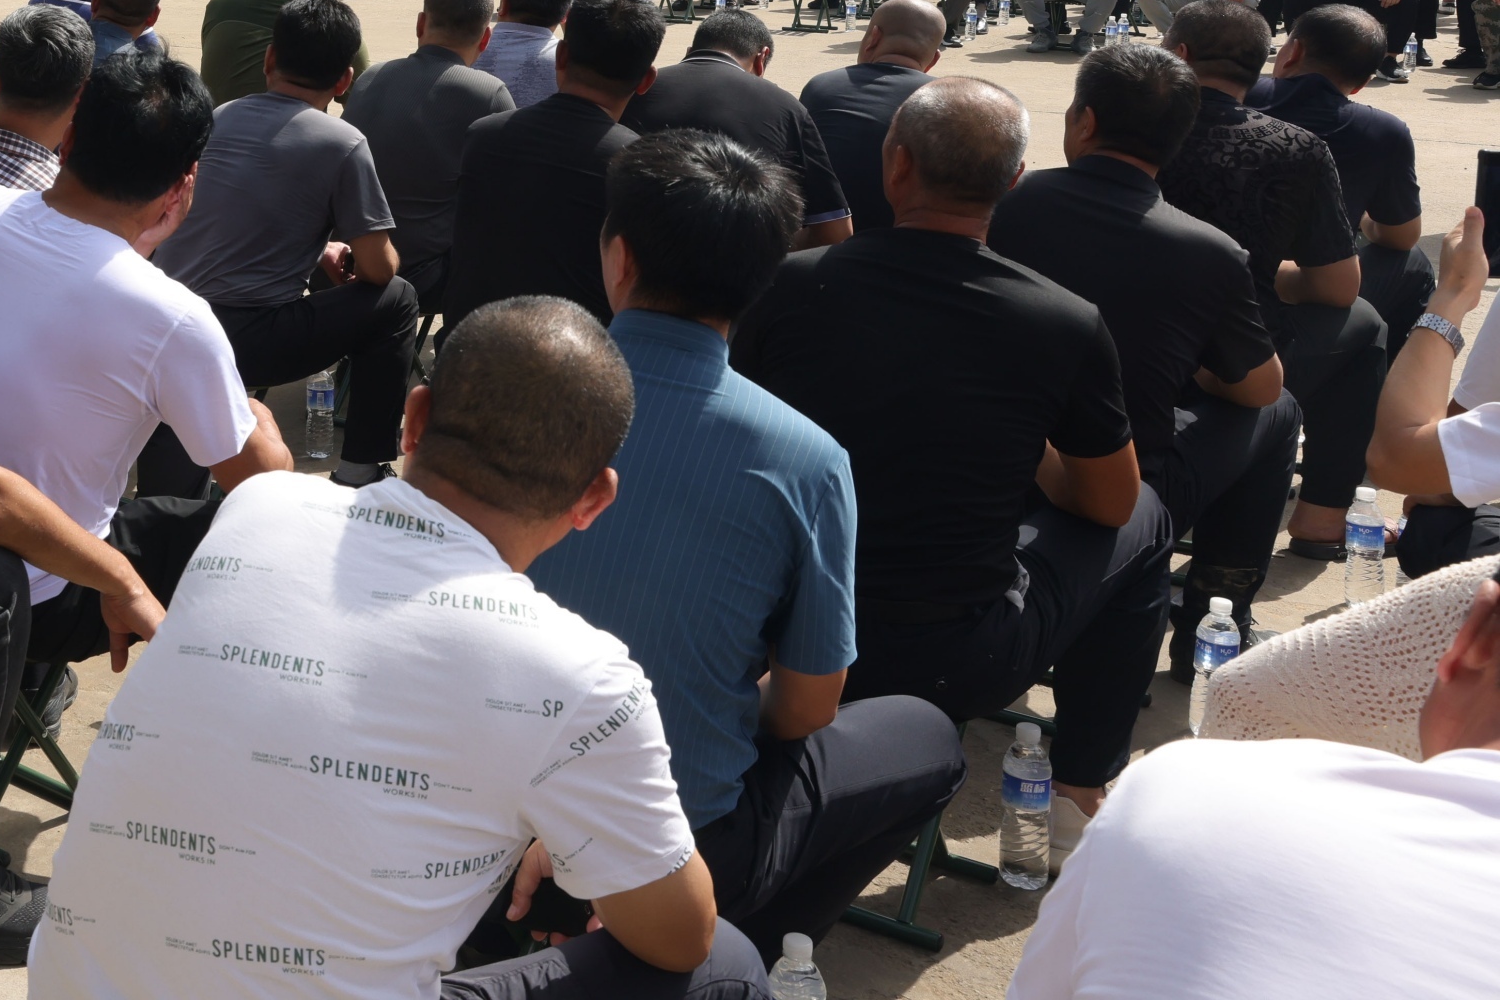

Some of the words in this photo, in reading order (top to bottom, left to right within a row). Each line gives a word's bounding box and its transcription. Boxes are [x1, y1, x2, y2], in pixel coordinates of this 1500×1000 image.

[346, 504, 445, 538] SPLENDENTS
[404, 532, 432, 542] WORKS
[428, 591, 538, 620] SPLENDENTS
[498, 617, 529, 628] WORKS
[220, 644, 325, 677] SPLENDENTS
[279, 673, 312, 685] WORKS
[542, 699, 563, 718] SP
[569, 677, 645, 756] SPLENDENTS
[309, 755, 430, 791] SPLENDENTS
[383, 787, 416, 799] WORKS
[126, 821, 216, 855] SPLENDENTS
[178, 852, 205, 864] WORKS
[212, 939, 325, 966] SPLENDENTS
[282, 967, 314, 976] WORKS
